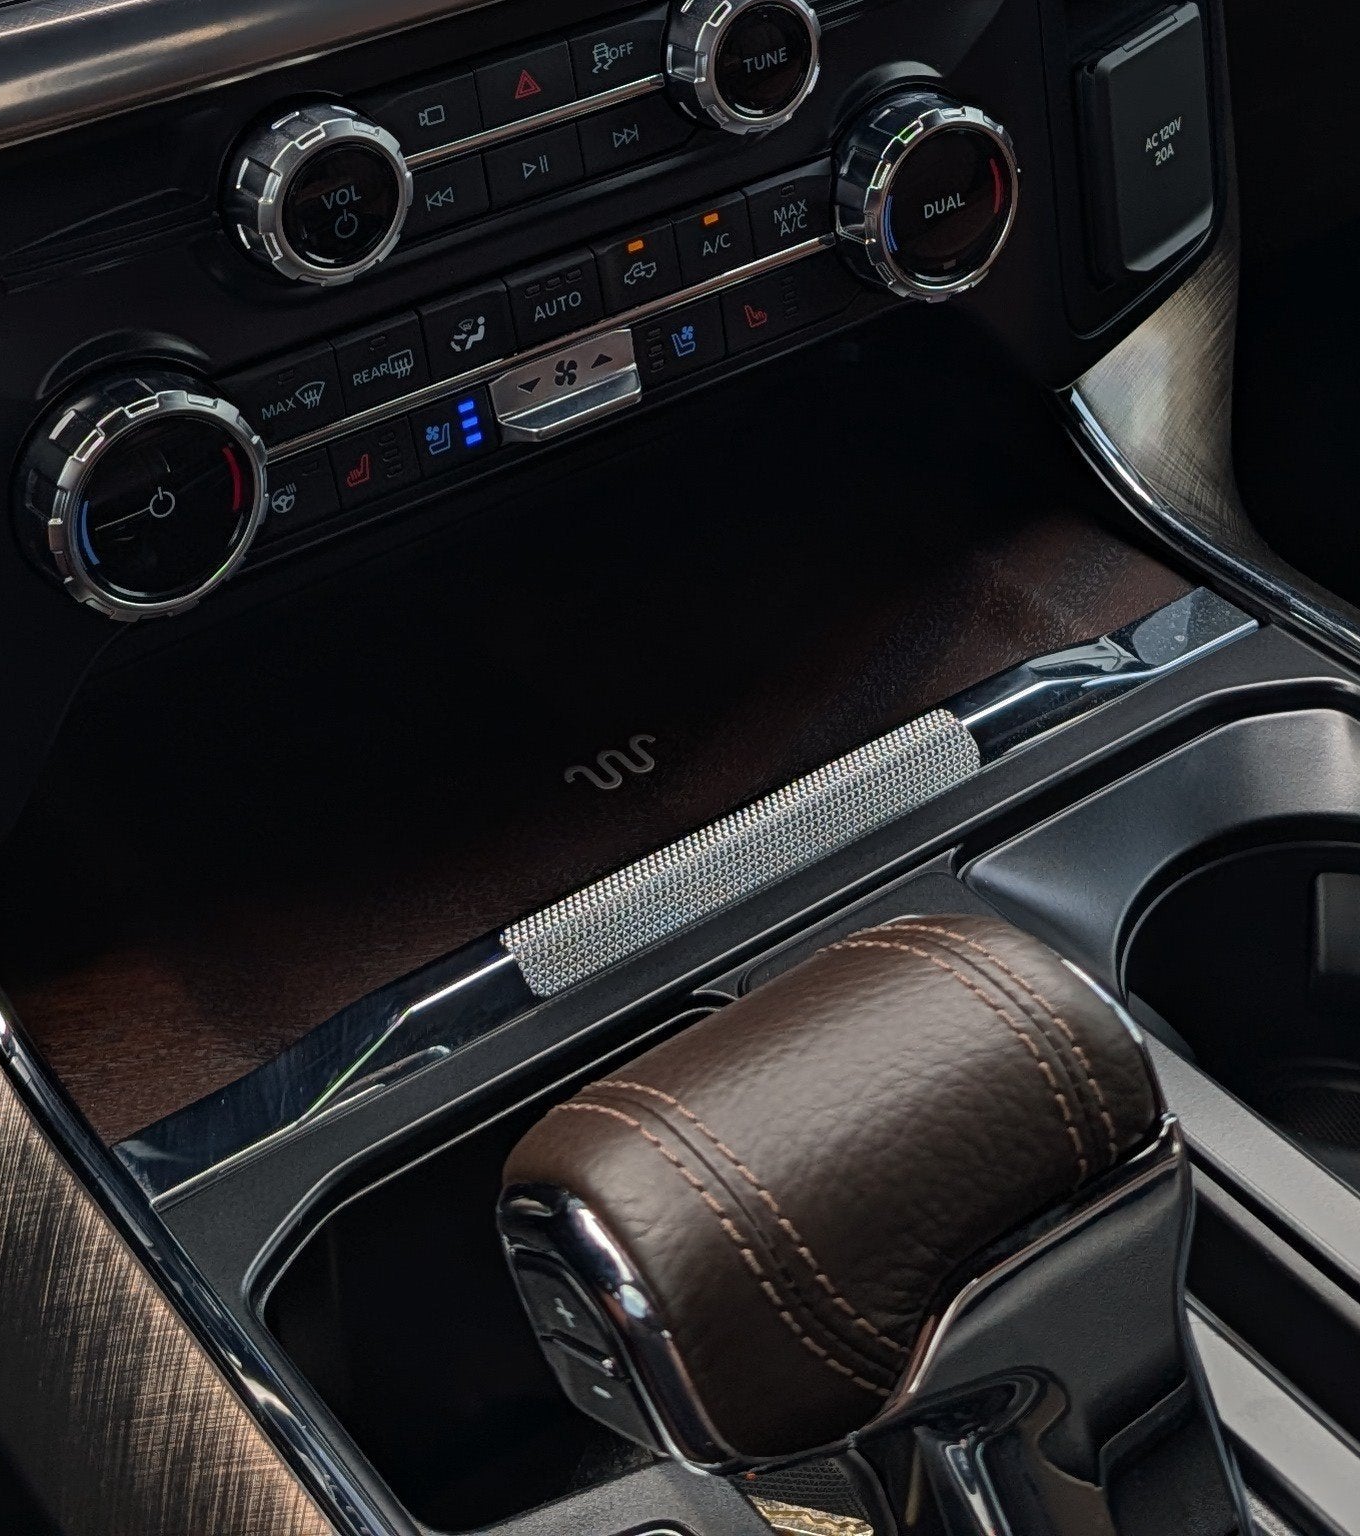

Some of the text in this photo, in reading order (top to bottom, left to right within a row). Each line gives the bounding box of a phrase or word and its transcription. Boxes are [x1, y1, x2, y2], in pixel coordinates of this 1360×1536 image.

[609, 42, 633, 60] OFF
[743, 47, 788, 74] TUNE
[1146, 116, 1182, 153] AC 120V
[1155, 142, 1174, 166] 20A
[321, 188, 361, 210] VOL
[773, 198, 808, 222] MAX
[924, 193, 965, 218] DUAL
[780, 215, 807, 237] A/C
[703, 233, 731, 256] A/C
[534, 291, 582, 322] AUTO
[353, 363, 389, 386] REAR
[261, 398, 295, 420] MAX
